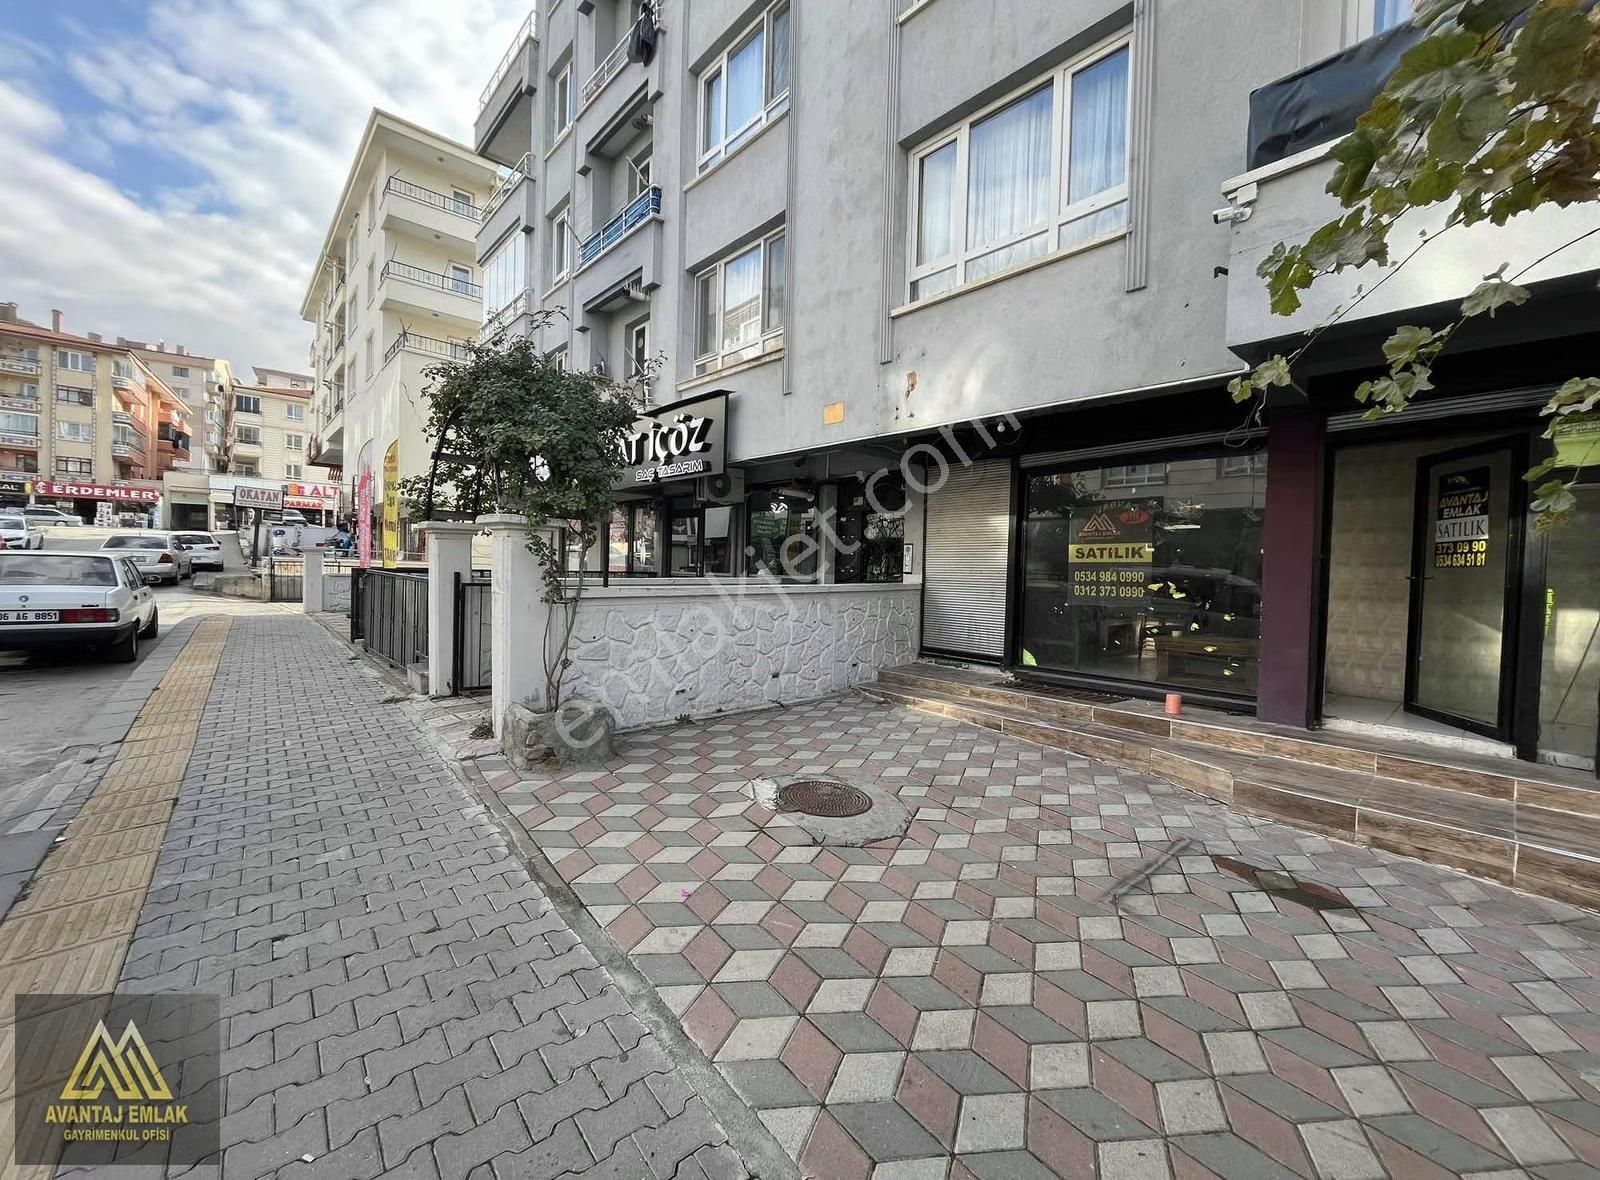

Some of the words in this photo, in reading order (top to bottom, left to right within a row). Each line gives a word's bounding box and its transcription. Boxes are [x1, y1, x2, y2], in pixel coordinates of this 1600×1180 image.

[648, 412, 705, 466] İÇÖZ
[635, 467, 655, 482] SAÇ
[656, 458, 703, 478] TASARIM
[239, 487, 280, 502] OKATAN
[1440, 491, 1488, 507] AVANTAJ
[1443, 504, 1481, 519] EMLAK
[1437, 519, 1486, 539] SATILIK
[1075, 546, 1144, 560] SATILIK
[1436, 542, 1454, 554] 373
[1457, 542, 1470, 553] 09
[1472, 540, 1487, 552] 90
[1466, 553, 1475, 567] 51
[1074, 571, 1097, 582] 0534
[1099, 571, 1118, 582] 984
[1119, 572, 1144, 583] 0990
[1074, 585, 1097, 596] 0312
[1099, 586, 1117, 597] 373
[1119, 586, 1144, 598] 0990
[16, 612, 28, 620] AG
[35, 612, 57, 620] 8851
